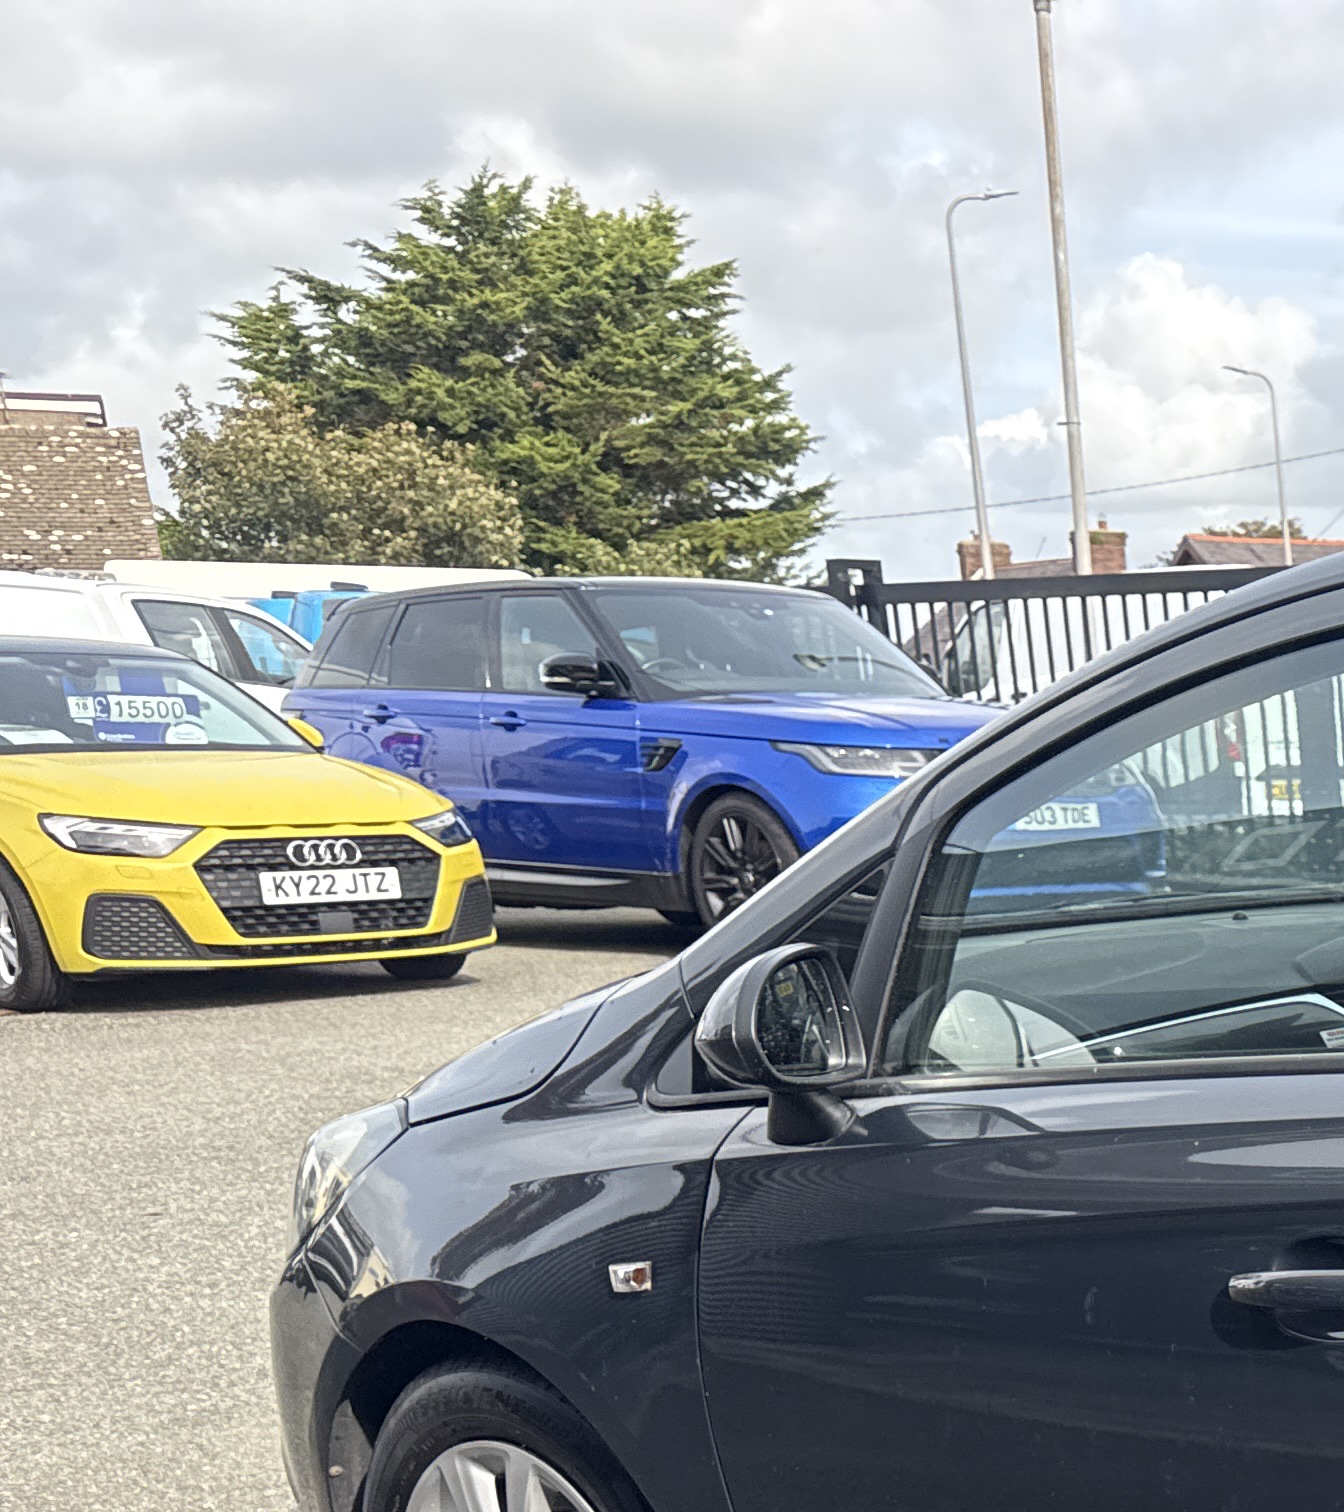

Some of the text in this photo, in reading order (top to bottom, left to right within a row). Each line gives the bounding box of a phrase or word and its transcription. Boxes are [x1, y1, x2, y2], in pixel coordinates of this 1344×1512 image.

[1061, 806, 1092, 825] TDE
[272, 872, 389, 897] KY22 JTZ
